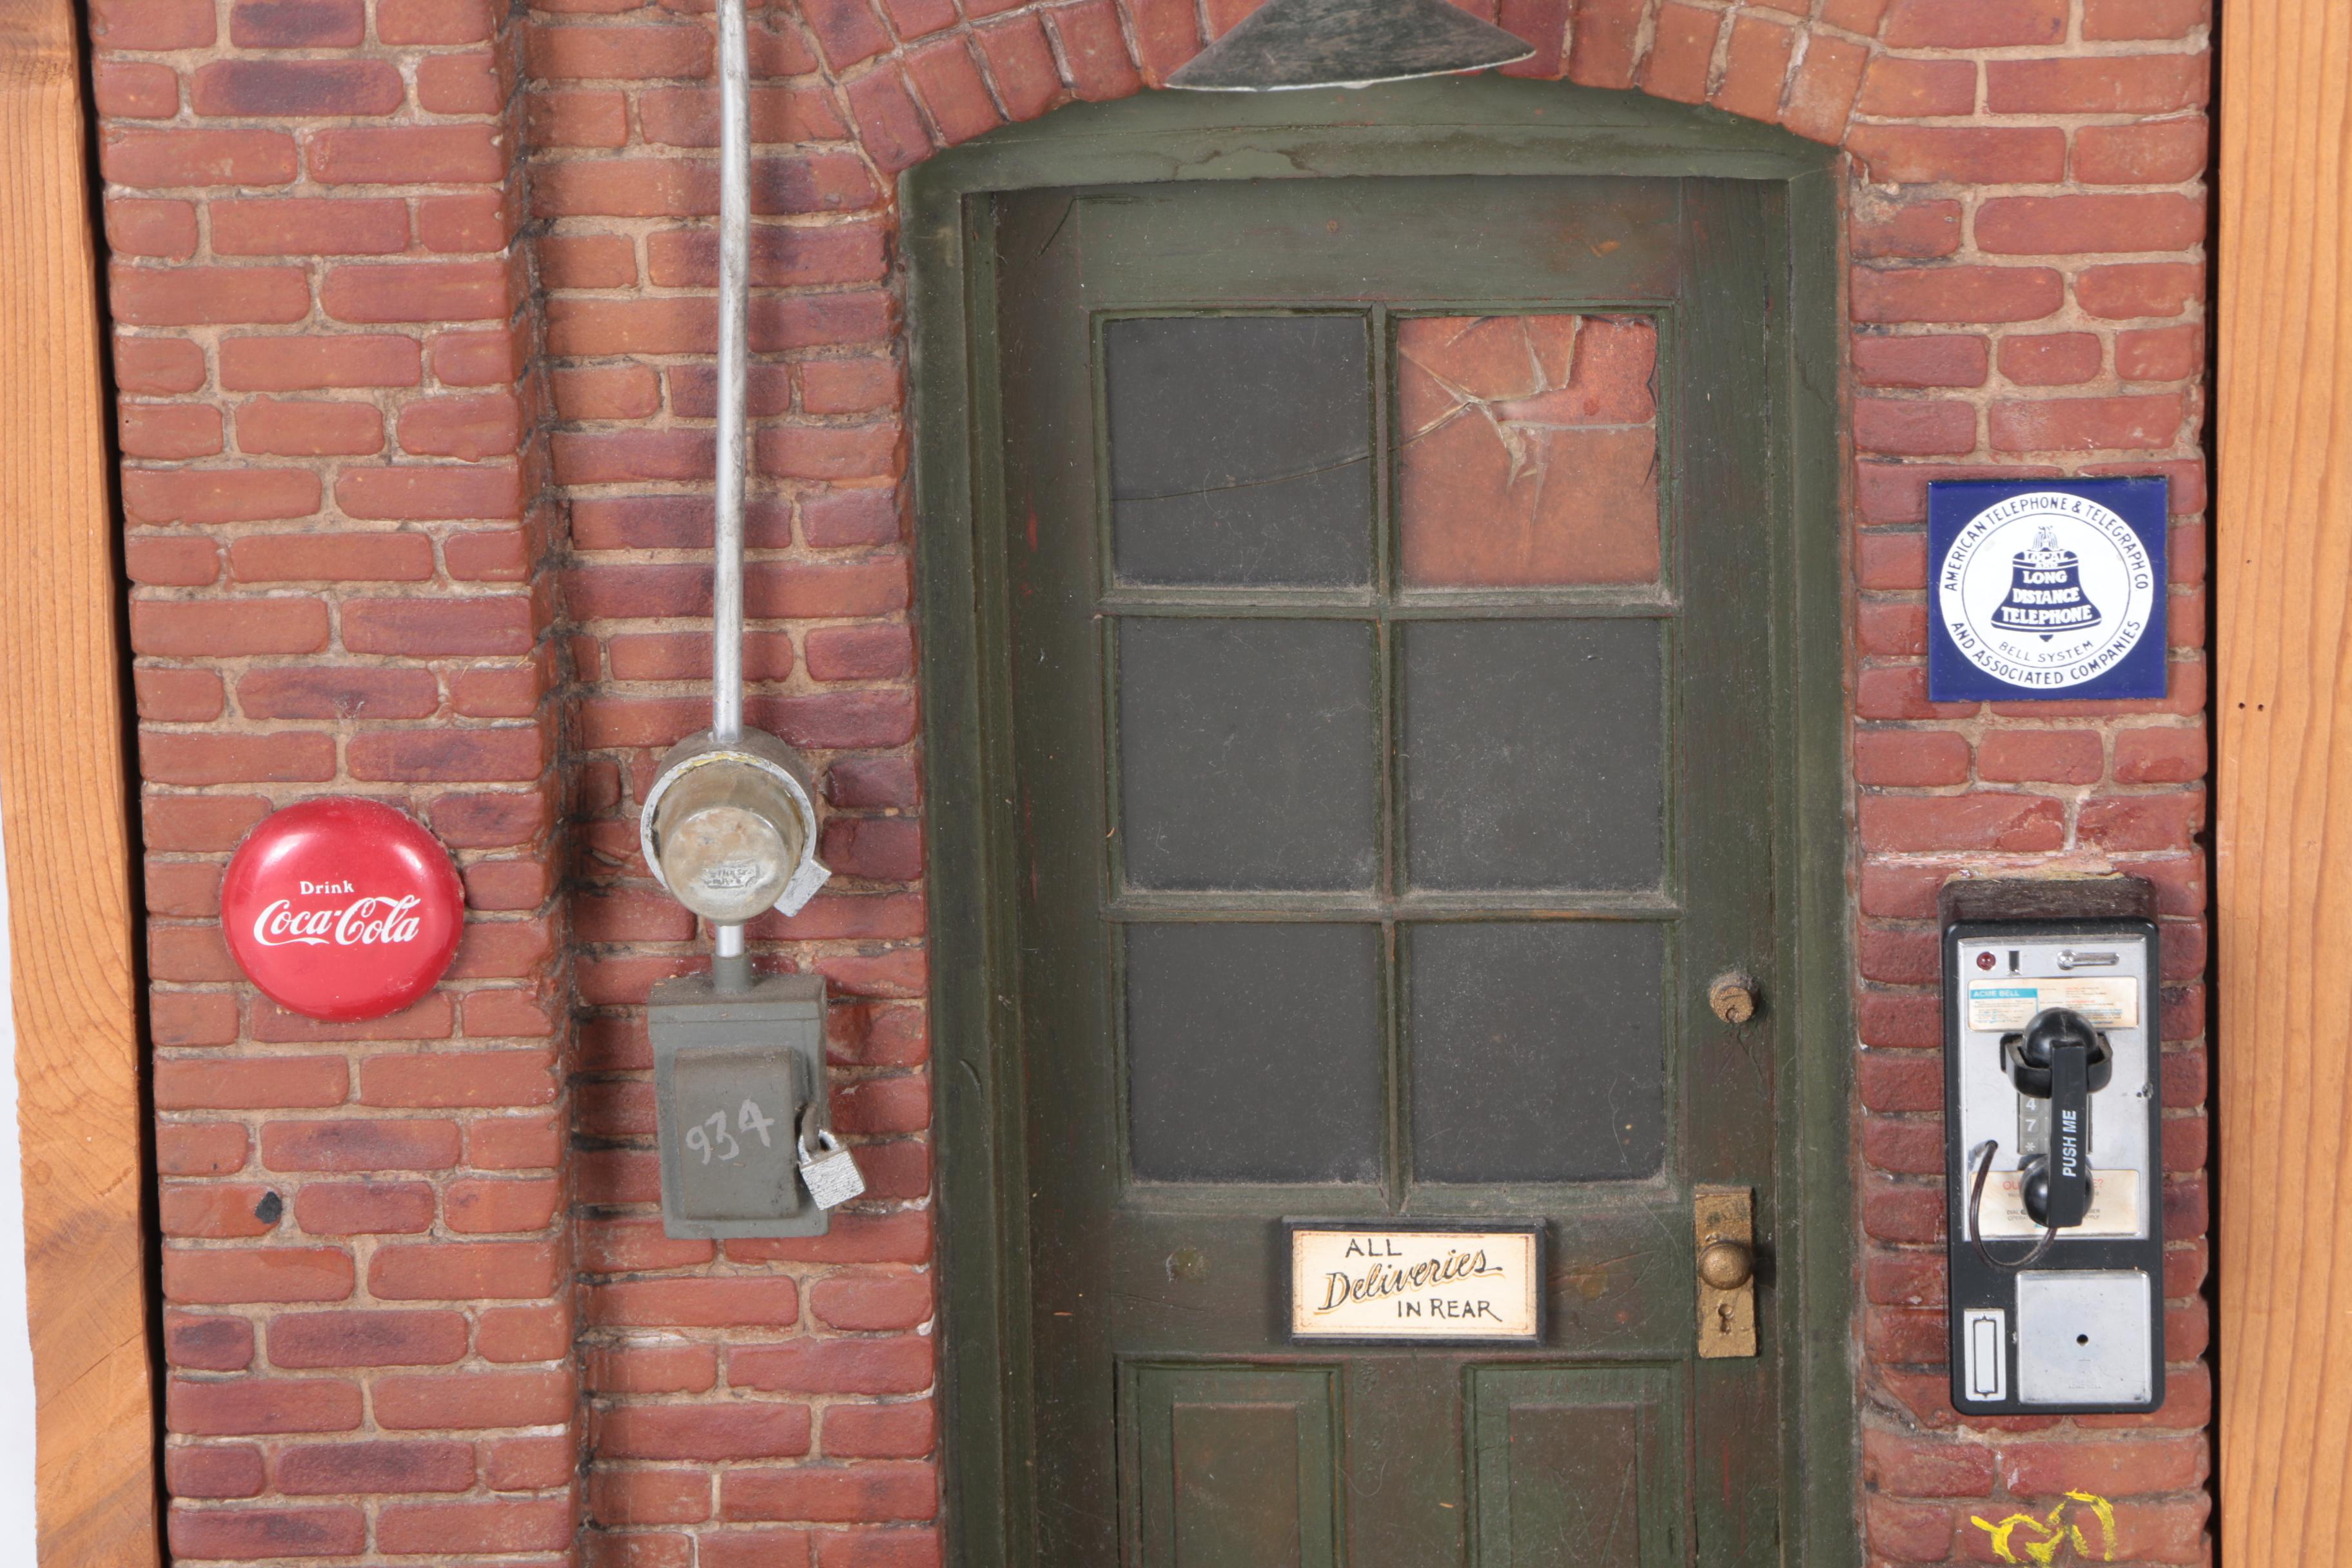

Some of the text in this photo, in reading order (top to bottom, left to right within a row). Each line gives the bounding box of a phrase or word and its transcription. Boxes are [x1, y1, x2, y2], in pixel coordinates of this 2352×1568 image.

[1945, 520, 1988, 591] AMERICAN
[1985, 496, 2068, 524] TELEPHONE
[2072, 501, 2082, 513] &
[2085, 504, 2146, 571] TELEGRAPH
[2023, 570, 2068, 585] LONG
[2012, 587, 2081, 604] DISTANCE
[2001, 605, 2093, 625] TELEPHONE
[1951, 620, 2141, 685] AND ASSOCIATED COMPANIES
[1999, 640, 2093, 663] BELL SYSTEM
[299, 879, 355, 895] Drink
[253, 895, 421, 946] Coca-Cola
[685, 1097, 775, 1166] 934
[2025, 1119, 2037, 1132] 7
[2062, 1109, 2077, 1177] PUSH ME
[1345, 1238, 1402, 1258] ALL
[1314, 1249, 1505, 1315] Deliveries
[1397, 1298, 1503, 1322] IN REAR
